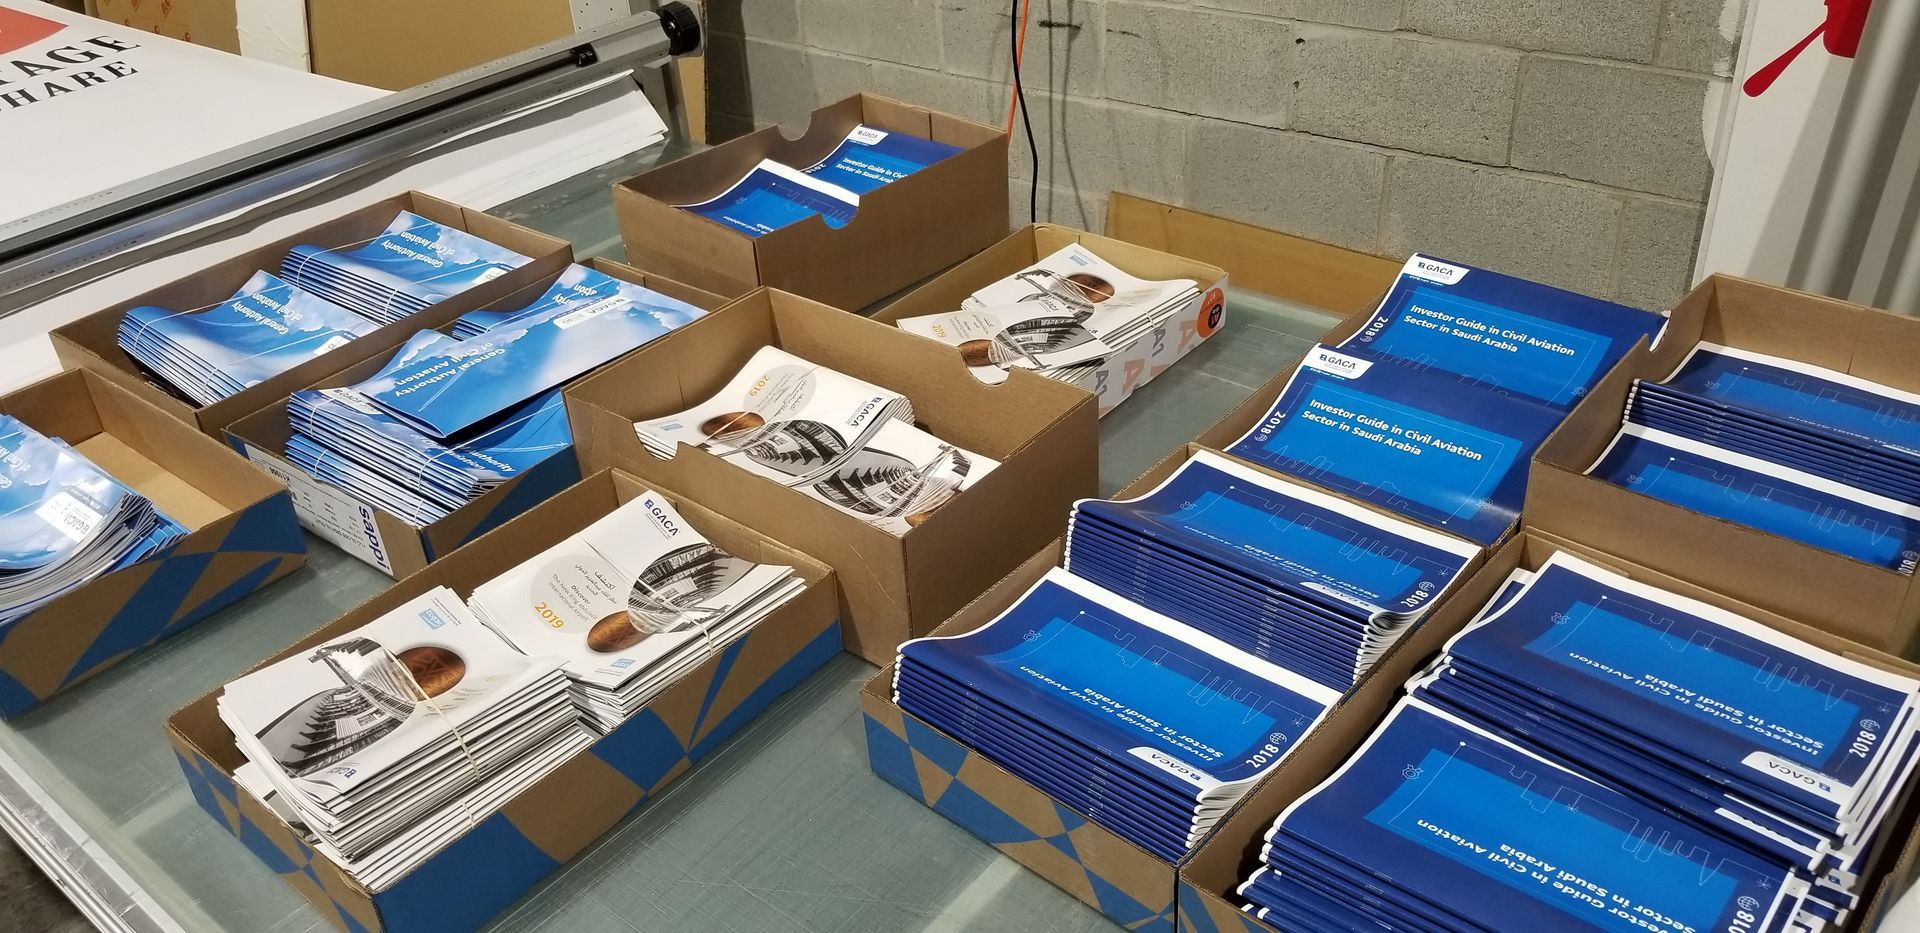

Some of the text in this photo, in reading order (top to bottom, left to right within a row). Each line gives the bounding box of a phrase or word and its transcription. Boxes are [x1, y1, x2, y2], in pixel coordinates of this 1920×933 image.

[0, 35, 141, 85] AGE
[0, 61, 138, 112] HARE
[836, 163, 856, 172] Sector
[862, 171, 878, 180] Saudi
[843, 157, 868, 168] Investor
[868, 165, 885, 173] Guide
[401, 231, 430, 246] Aviation
[380, 239, 443, 268] General Authority
[1426, 264, 1453, 276] GACA
[252, 292, 281, 313] Aviation
[231, 301, 289, 335] General Authority
[1366, 315, 1389, 337] 2018
[1410, 304, 1575, 356] Investor Guide in Civil Aviation
[1404, 315, 1518, 353] Sector in Saudi Arabia
[451, 349, 479, 363] Civil
[1328, 356, 1357, 370] GACA
[395, 349, 506, 397] General Authority
[396, 360, 450, 385] Aviation
[749, 373, 771, 397] 2019
[850, 400, 875, 429] GACA
[1260, 411, 1286, 434] 2018
[1302, 410, 1422, 456] Sector in Saudi Arabia
[1309, 399, 1482, 461] Investor Guide in Civil Aviation
[469, 450, 516, 472] uthority
[652, 507, 680, 536] GACA
[359, 505, 390, 570] sappi
[571, 585, 592, 605] Discover
[1400, 589, 1429, 608] 2018
[534, 601, 564, 630] 2019
[1020, 665, 1213, 762] Investor Guide in Civil Aviation
[1568, 652, 1819, 756] Investor Guide in Civil Aviation
[1644, 673, 1825, 750] Sector in Saudi Arabia
[1083, 687, 1224, 758] Sector in Saudi Arabia
[1245, 743, 1279, 769] 2018
[1848, 730, 1877, 758] 2018
[1152, 753, 1188, 775] GACA
[1768, 760, 1815, 785] GACA
[1417, 819, 1487, 853] Aviation
[1488, 852, 1527, 872] Civil
[1500, 843, 1556, 872] Arabia
[1532, 871, 1549, 884] in
[1556, 870, 1608, 896] Saudi
[1553, 881, 1605, 908] Guide
[1612, 894, 1630, 908] in
[1727, 910, 1755, 933] 018
